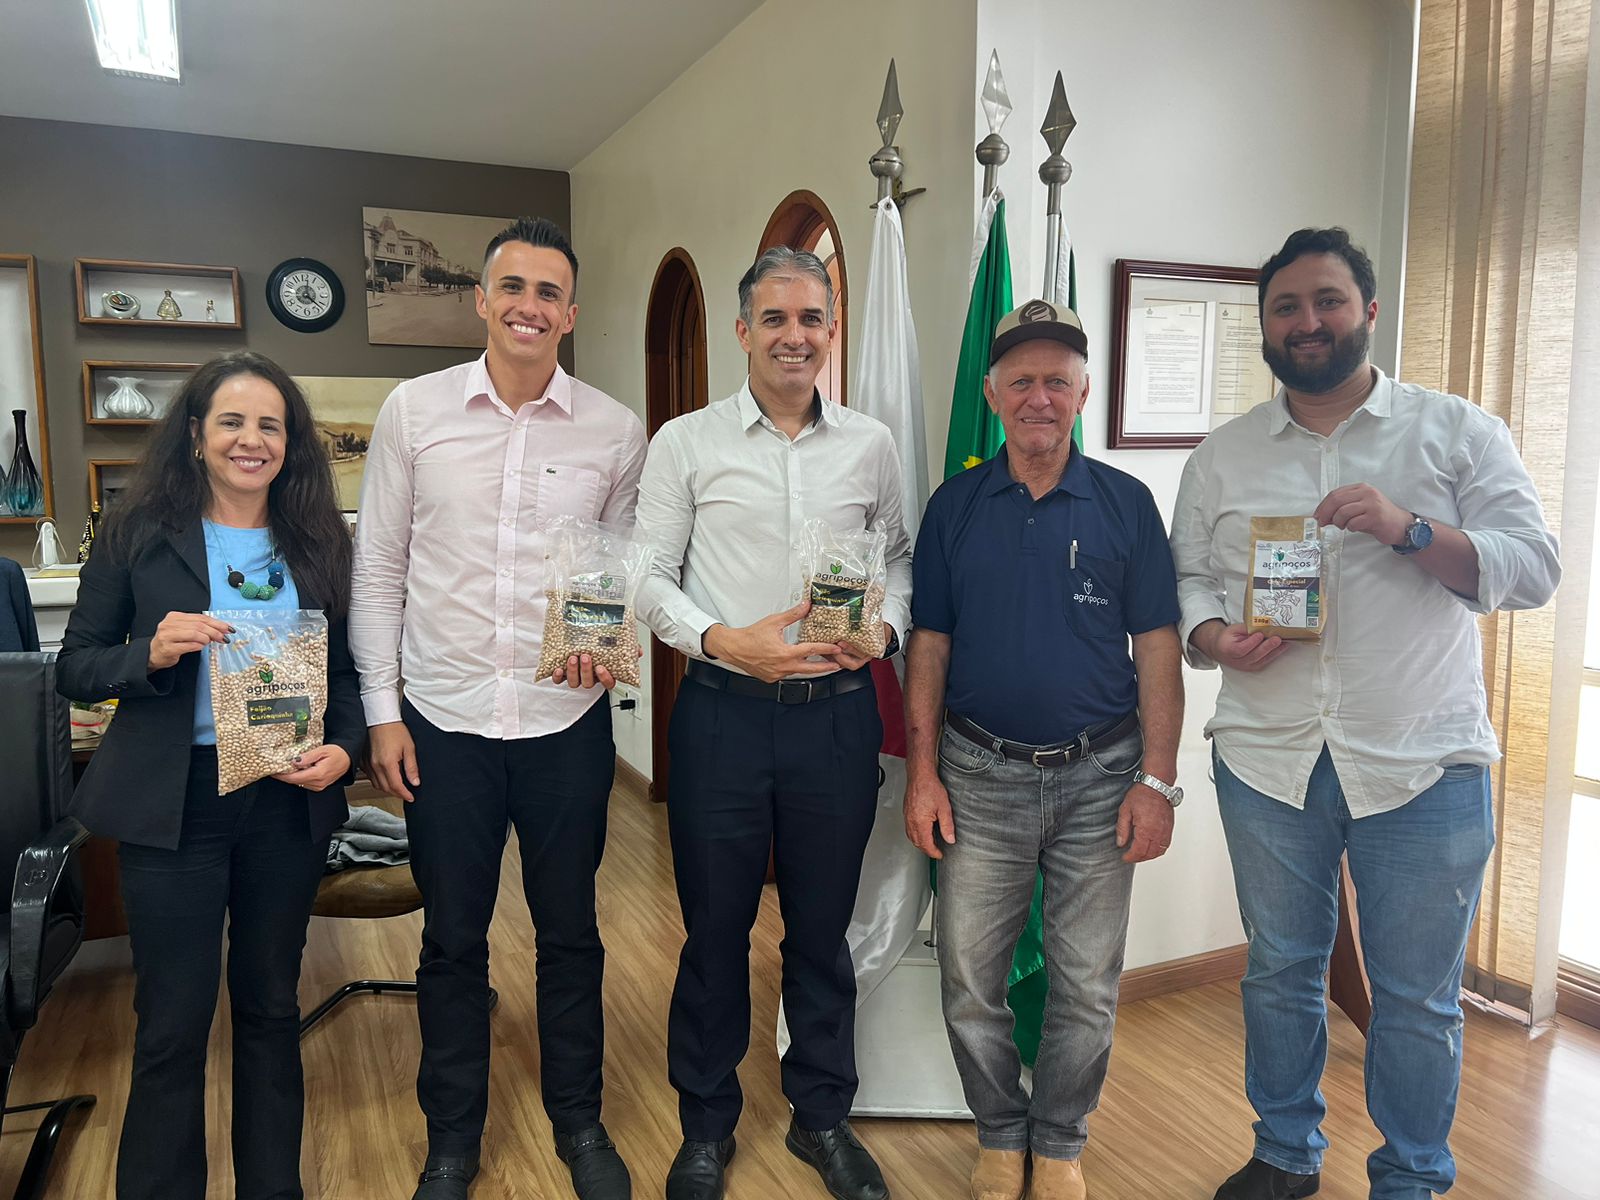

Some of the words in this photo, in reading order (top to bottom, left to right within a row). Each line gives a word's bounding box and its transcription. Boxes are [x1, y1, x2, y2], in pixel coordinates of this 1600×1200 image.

[301, 274, 309, 282] 12
[286, 298, 296, 307] 8
[303, 307, 311, 317] 6
[815, 571, 869, 586] agripoços
[1073, 593, 1109, 606] agripoços
[246, 682, 306, 696] agripoços
